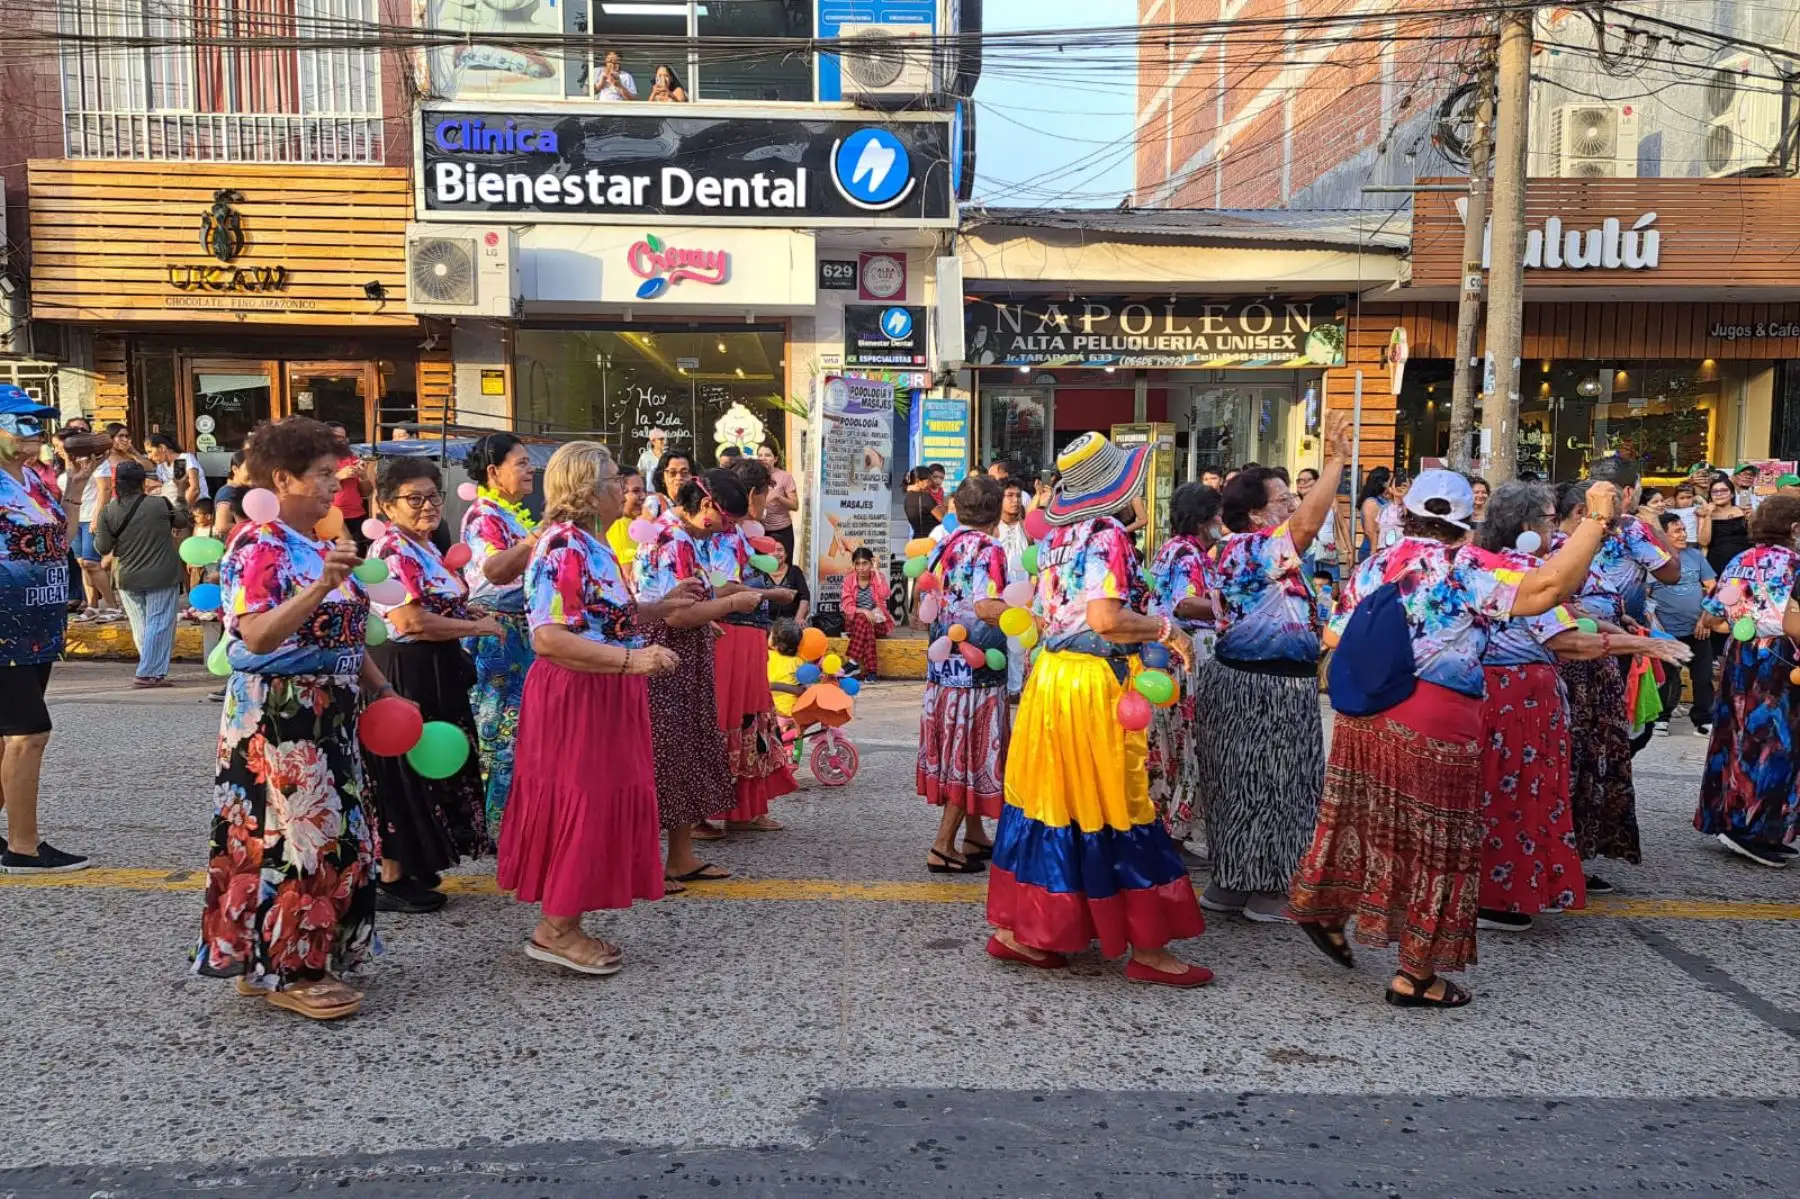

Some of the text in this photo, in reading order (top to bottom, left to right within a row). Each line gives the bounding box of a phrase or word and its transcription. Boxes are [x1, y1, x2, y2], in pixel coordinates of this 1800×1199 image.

[434, 118, 558, 153] Clínica
[434, 161, 807, 209] Bienestar Dental
[1454, 196, 1660, 270] ululú
[486, 249, 498, 257] LG
[167, 264, 286, 292] UKAW
[822, 264, 854, 278] 629
[994, 298, 1313, 335] NAPOLEÓN
[1711, 322, 1752, 340] Jugos
[1755, 322, 1766, 337] &
[1010, 335, 1297, 351] ALTA PELUQUERIA UNISEX
[859, 355, 912, 363] ESPECIALISTAS
[636, 387, 667, 407] Hoy
